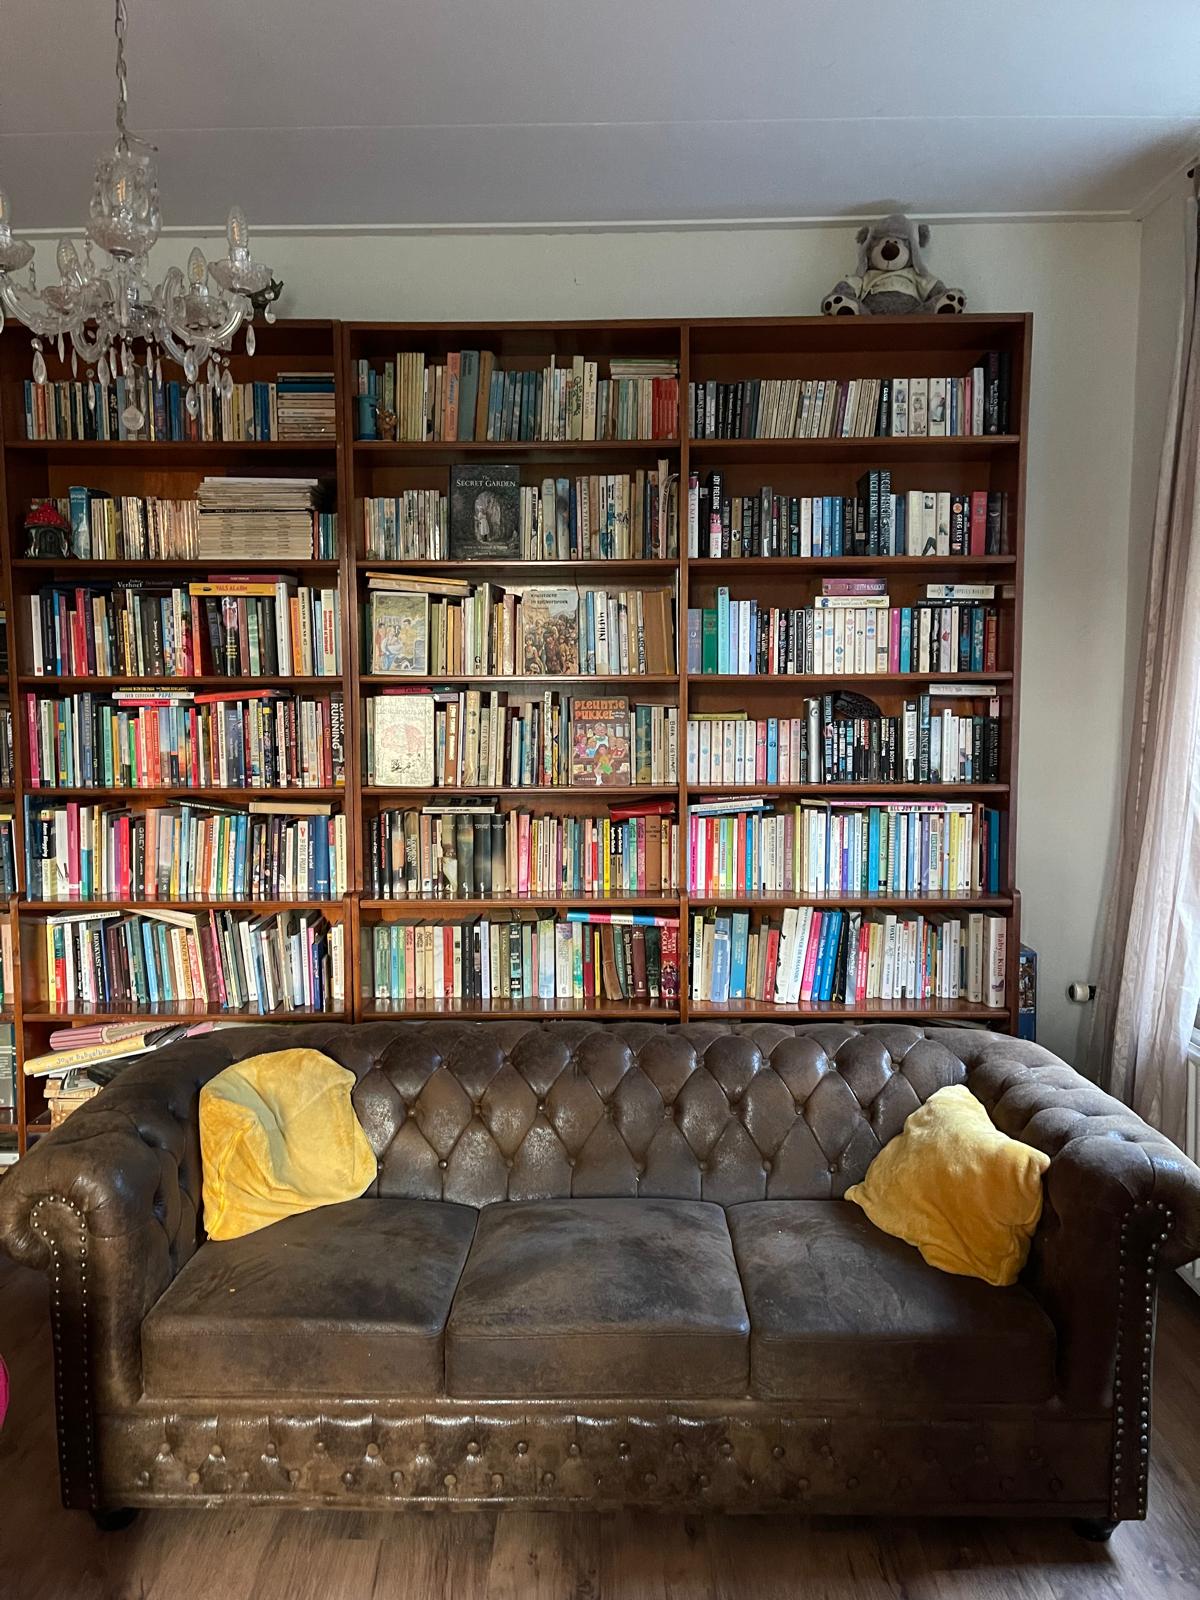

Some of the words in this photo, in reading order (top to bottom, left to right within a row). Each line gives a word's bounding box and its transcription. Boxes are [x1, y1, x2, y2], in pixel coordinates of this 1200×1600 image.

[870, 473, 879, 490] NICCI
[870, 493, 878, 518] FRENCH
[117, 581, 144, 589] Verhoef
[331, 702, 339, 750] RUNNING
[921, 731, 929, 752] SINCE
[920, 753, 929, 772] RUBY
[996, 933, 1004, 950] Baby
